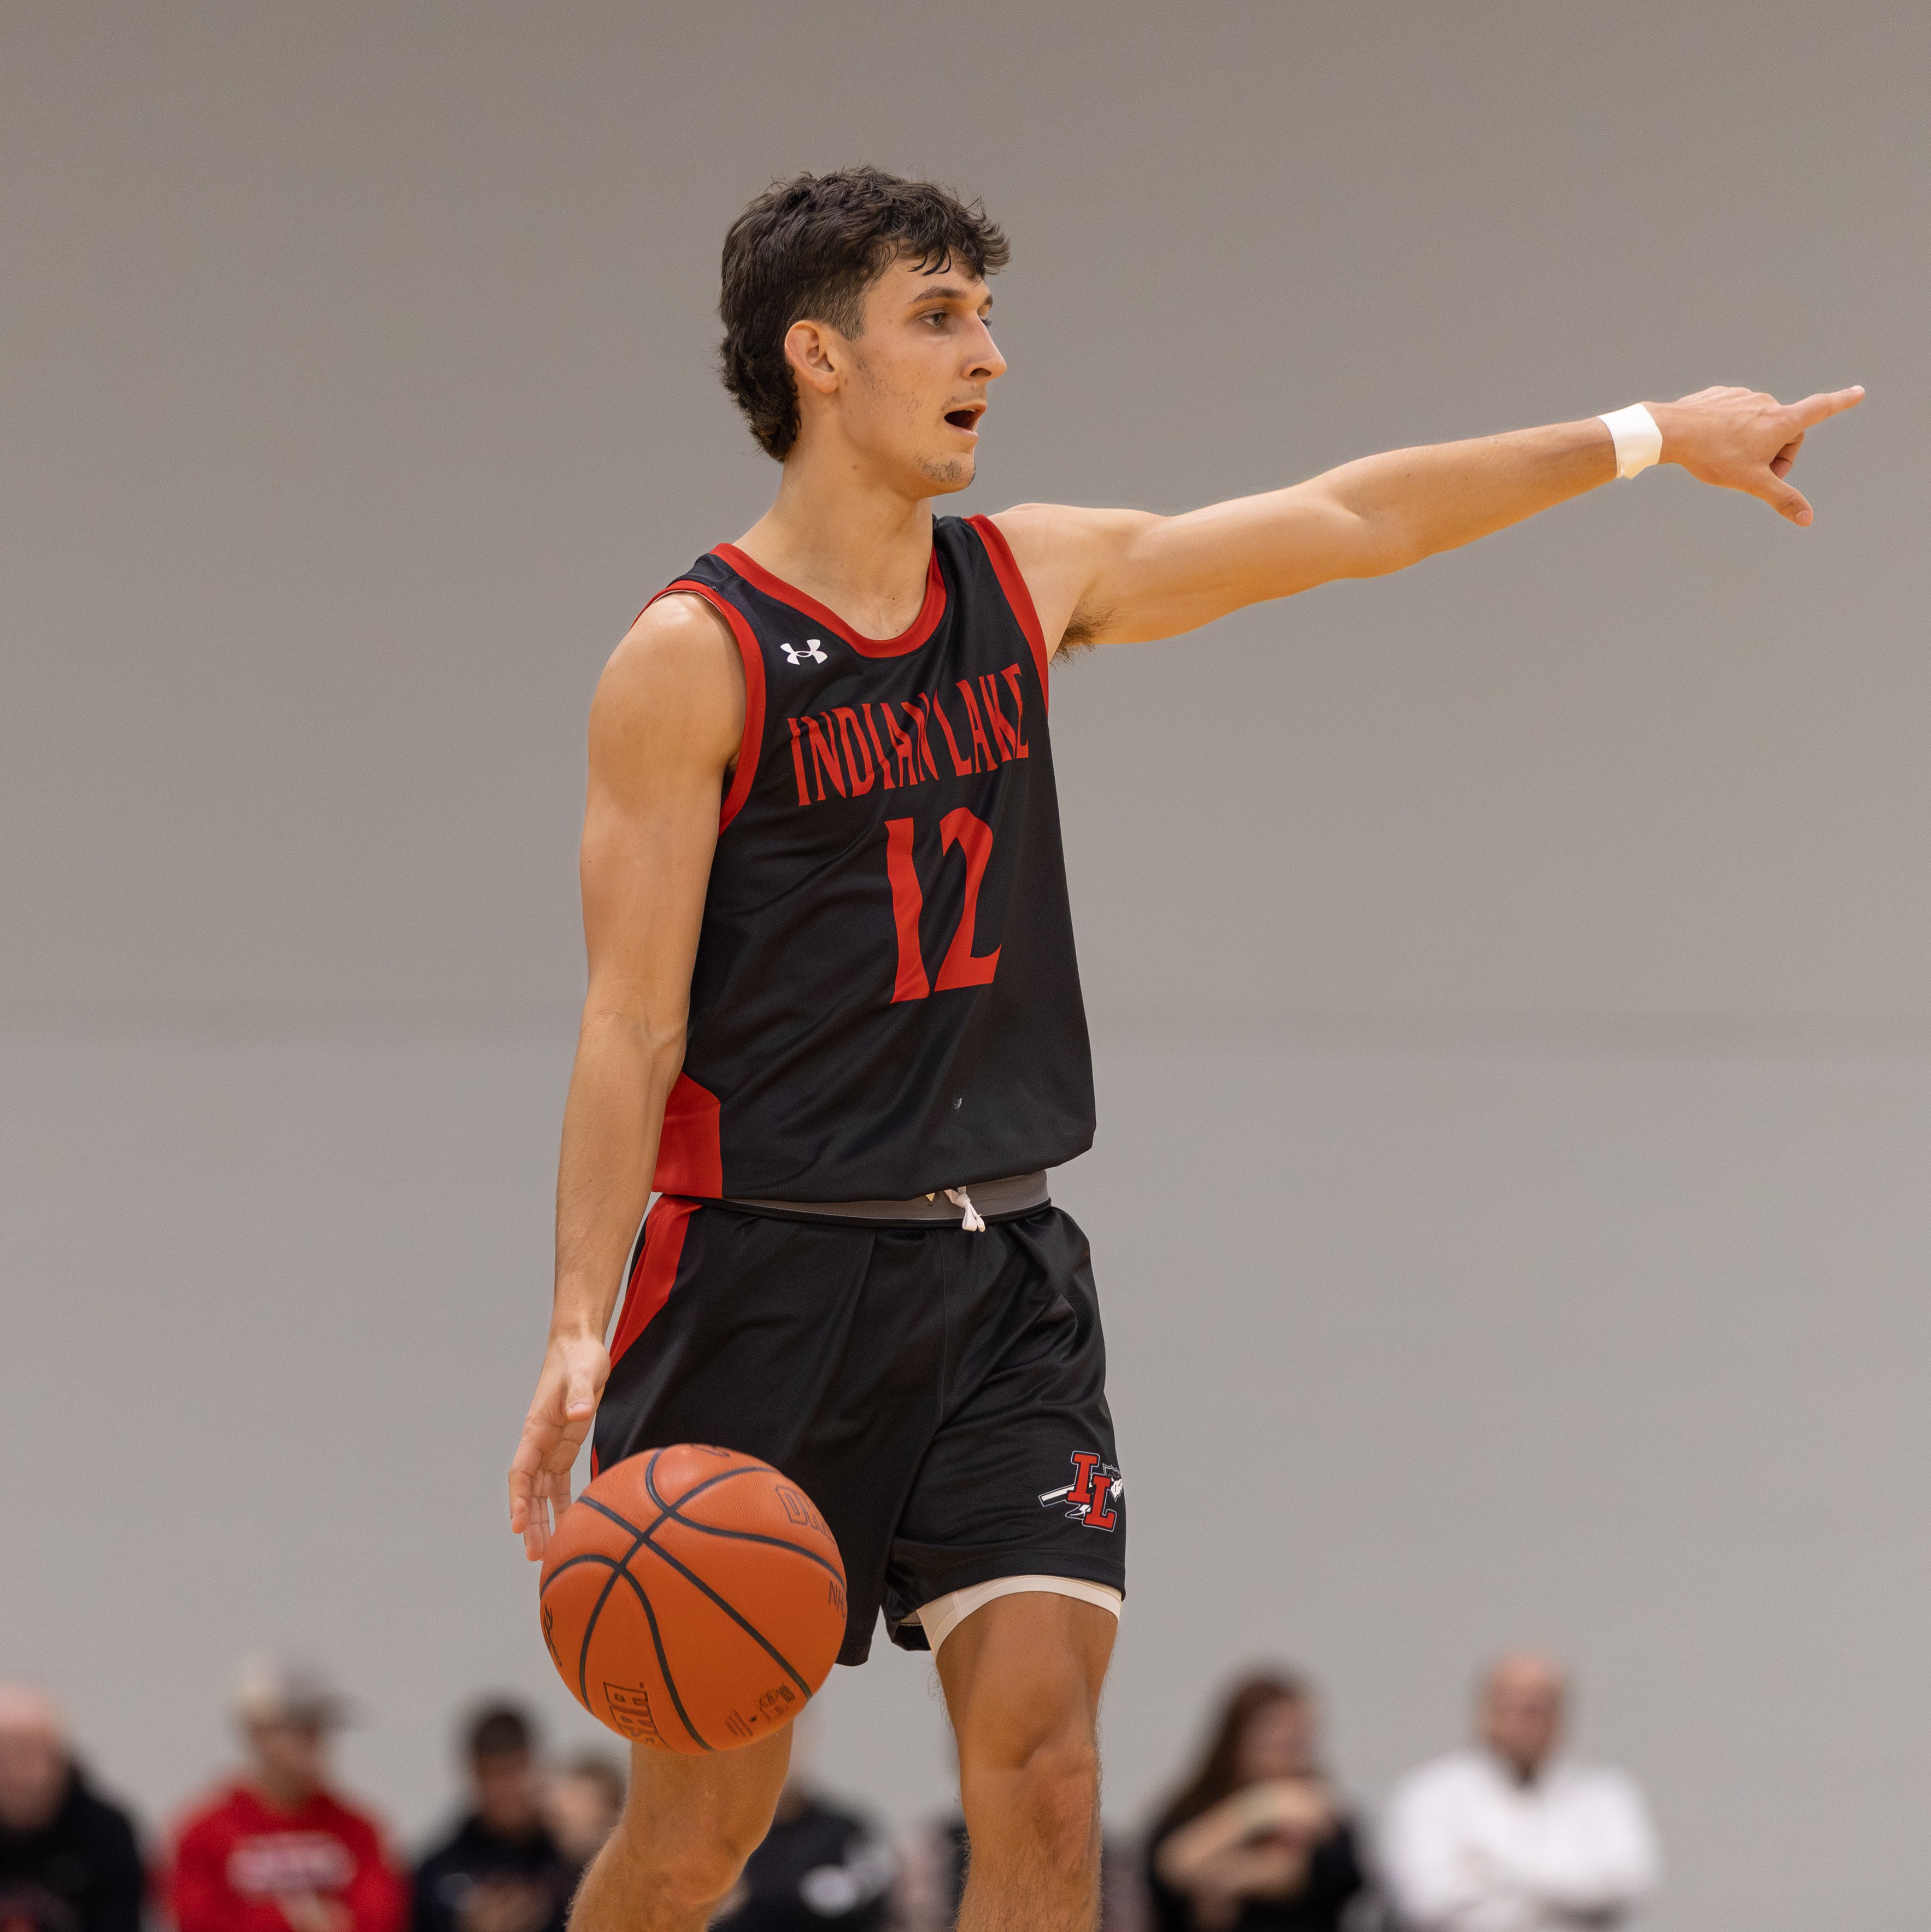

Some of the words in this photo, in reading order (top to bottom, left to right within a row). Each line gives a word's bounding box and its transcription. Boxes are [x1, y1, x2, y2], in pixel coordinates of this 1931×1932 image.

[787, 692, 940, 806] INDIAN
[932, 663, 1029, 777] LAKE
[884, 806, 1002, 1004] 12
